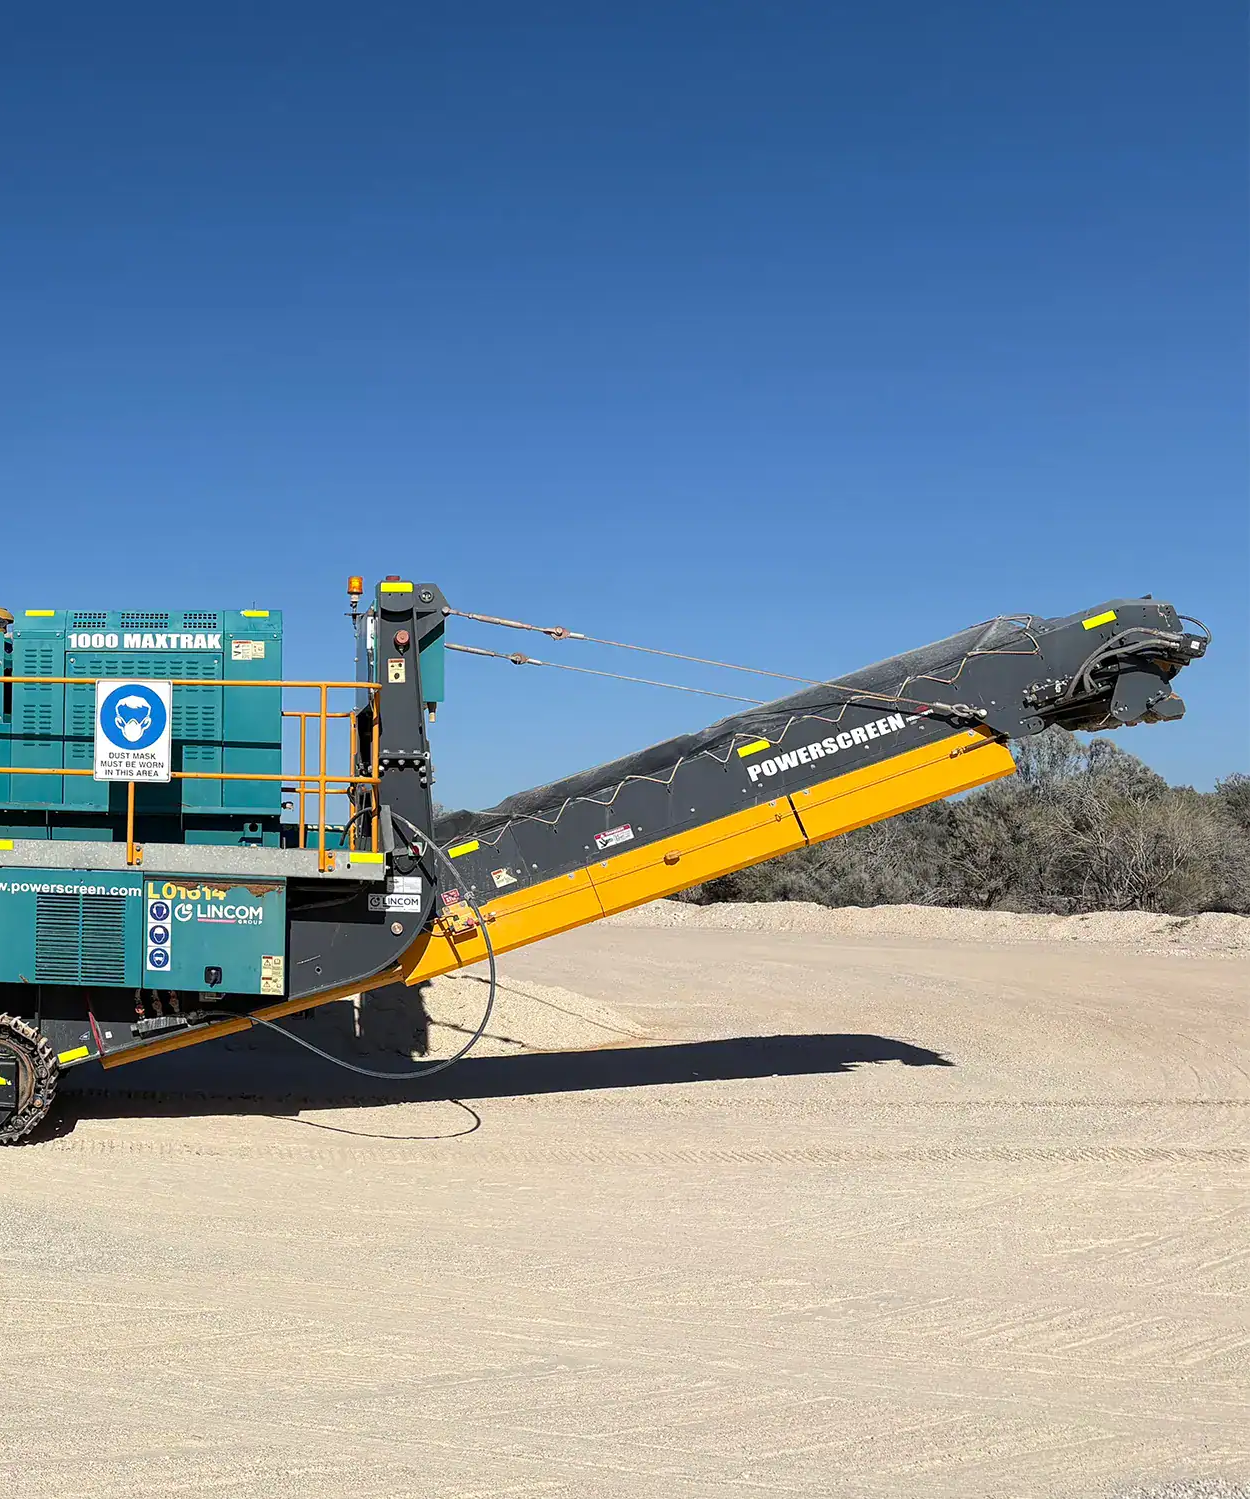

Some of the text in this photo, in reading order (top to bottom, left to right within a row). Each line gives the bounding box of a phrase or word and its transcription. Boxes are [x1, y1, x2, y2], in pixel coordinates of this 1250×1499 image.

[68, 633, 222, 649] 1000 MAXTRAK
[747, 713, 906, 782] POWERSCREEN
[108, 752, 156, 760] DUST MASK
[100, 760, 123, 768] MUST
[138, 761, 164, 769] WORN
[115, 769, 134, 777] THIS
[382, 897, 419, 906] LINCOM
[196, 904, 263, 920] LINCOM
